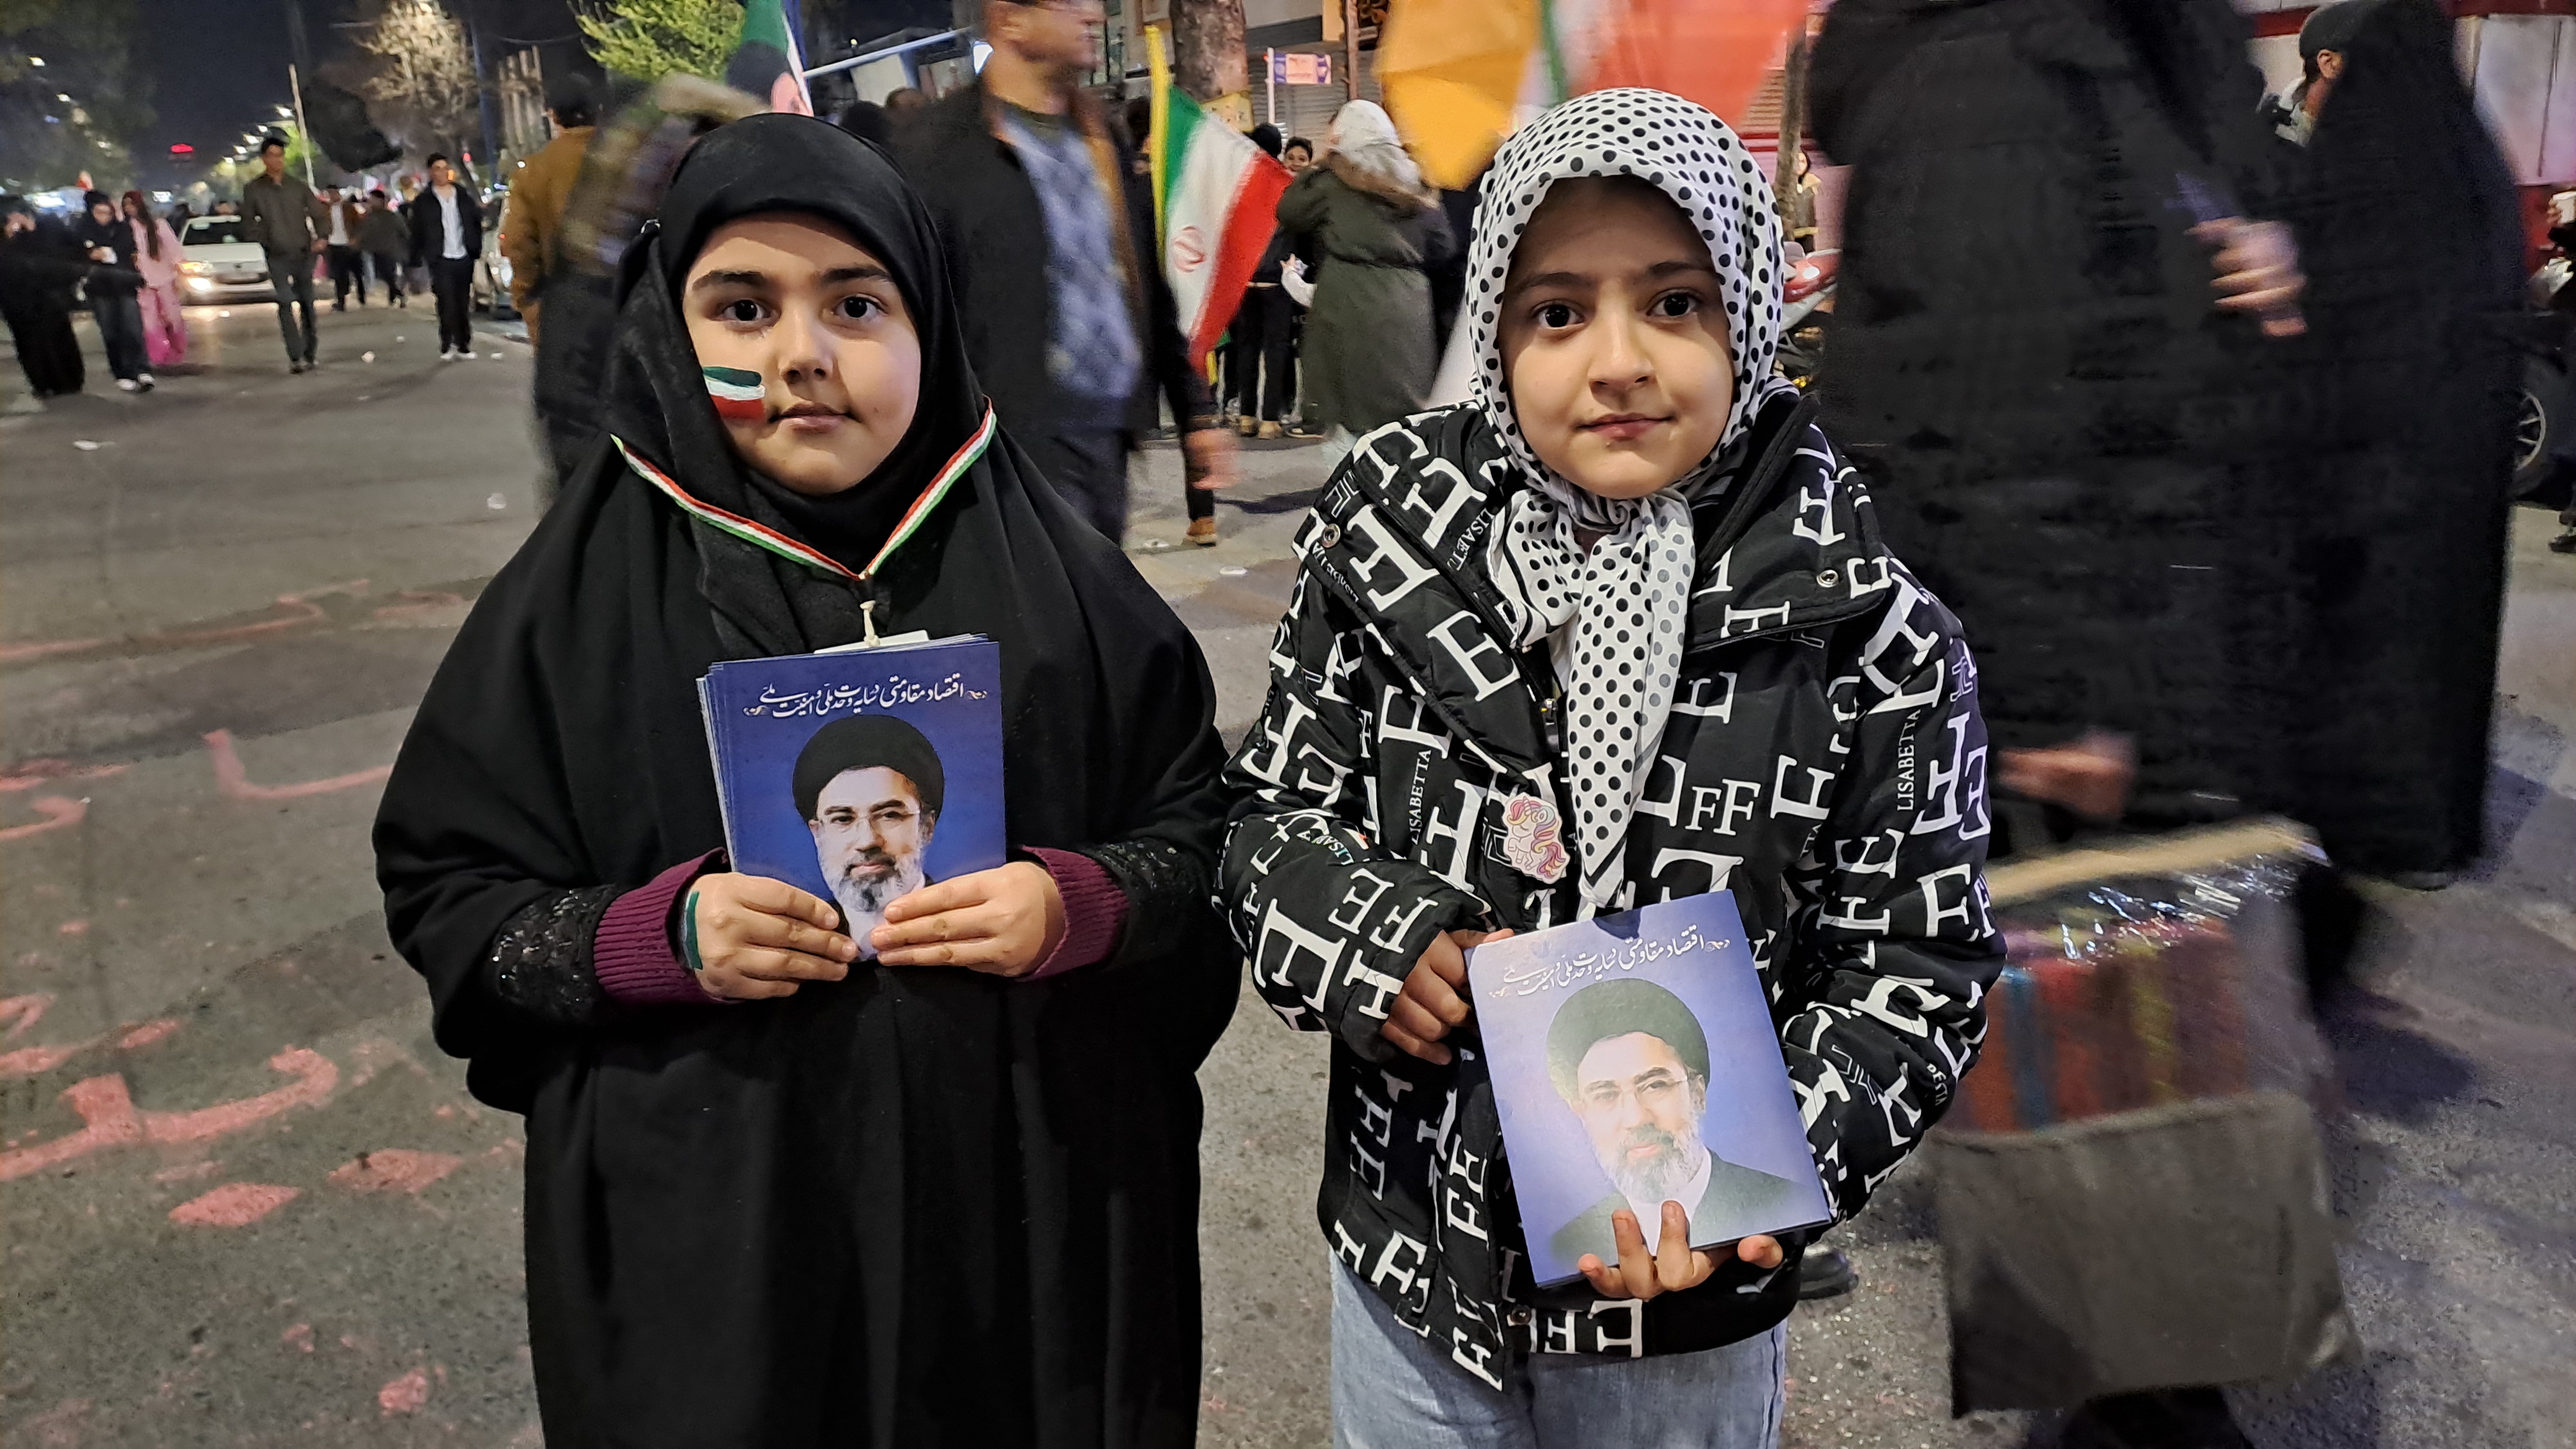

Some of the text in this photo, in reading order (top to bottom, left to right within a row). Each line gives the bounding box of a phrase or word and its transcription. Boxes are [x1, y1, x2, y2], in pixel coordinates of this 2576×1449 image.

[879, 675, 925, 708] مقاومتی
[925, 672, 965, 702] اقتصاد
[1897, 708, 1921, 811] LISABETTA
[1667, 924, 1705, 958] اقتصاد
